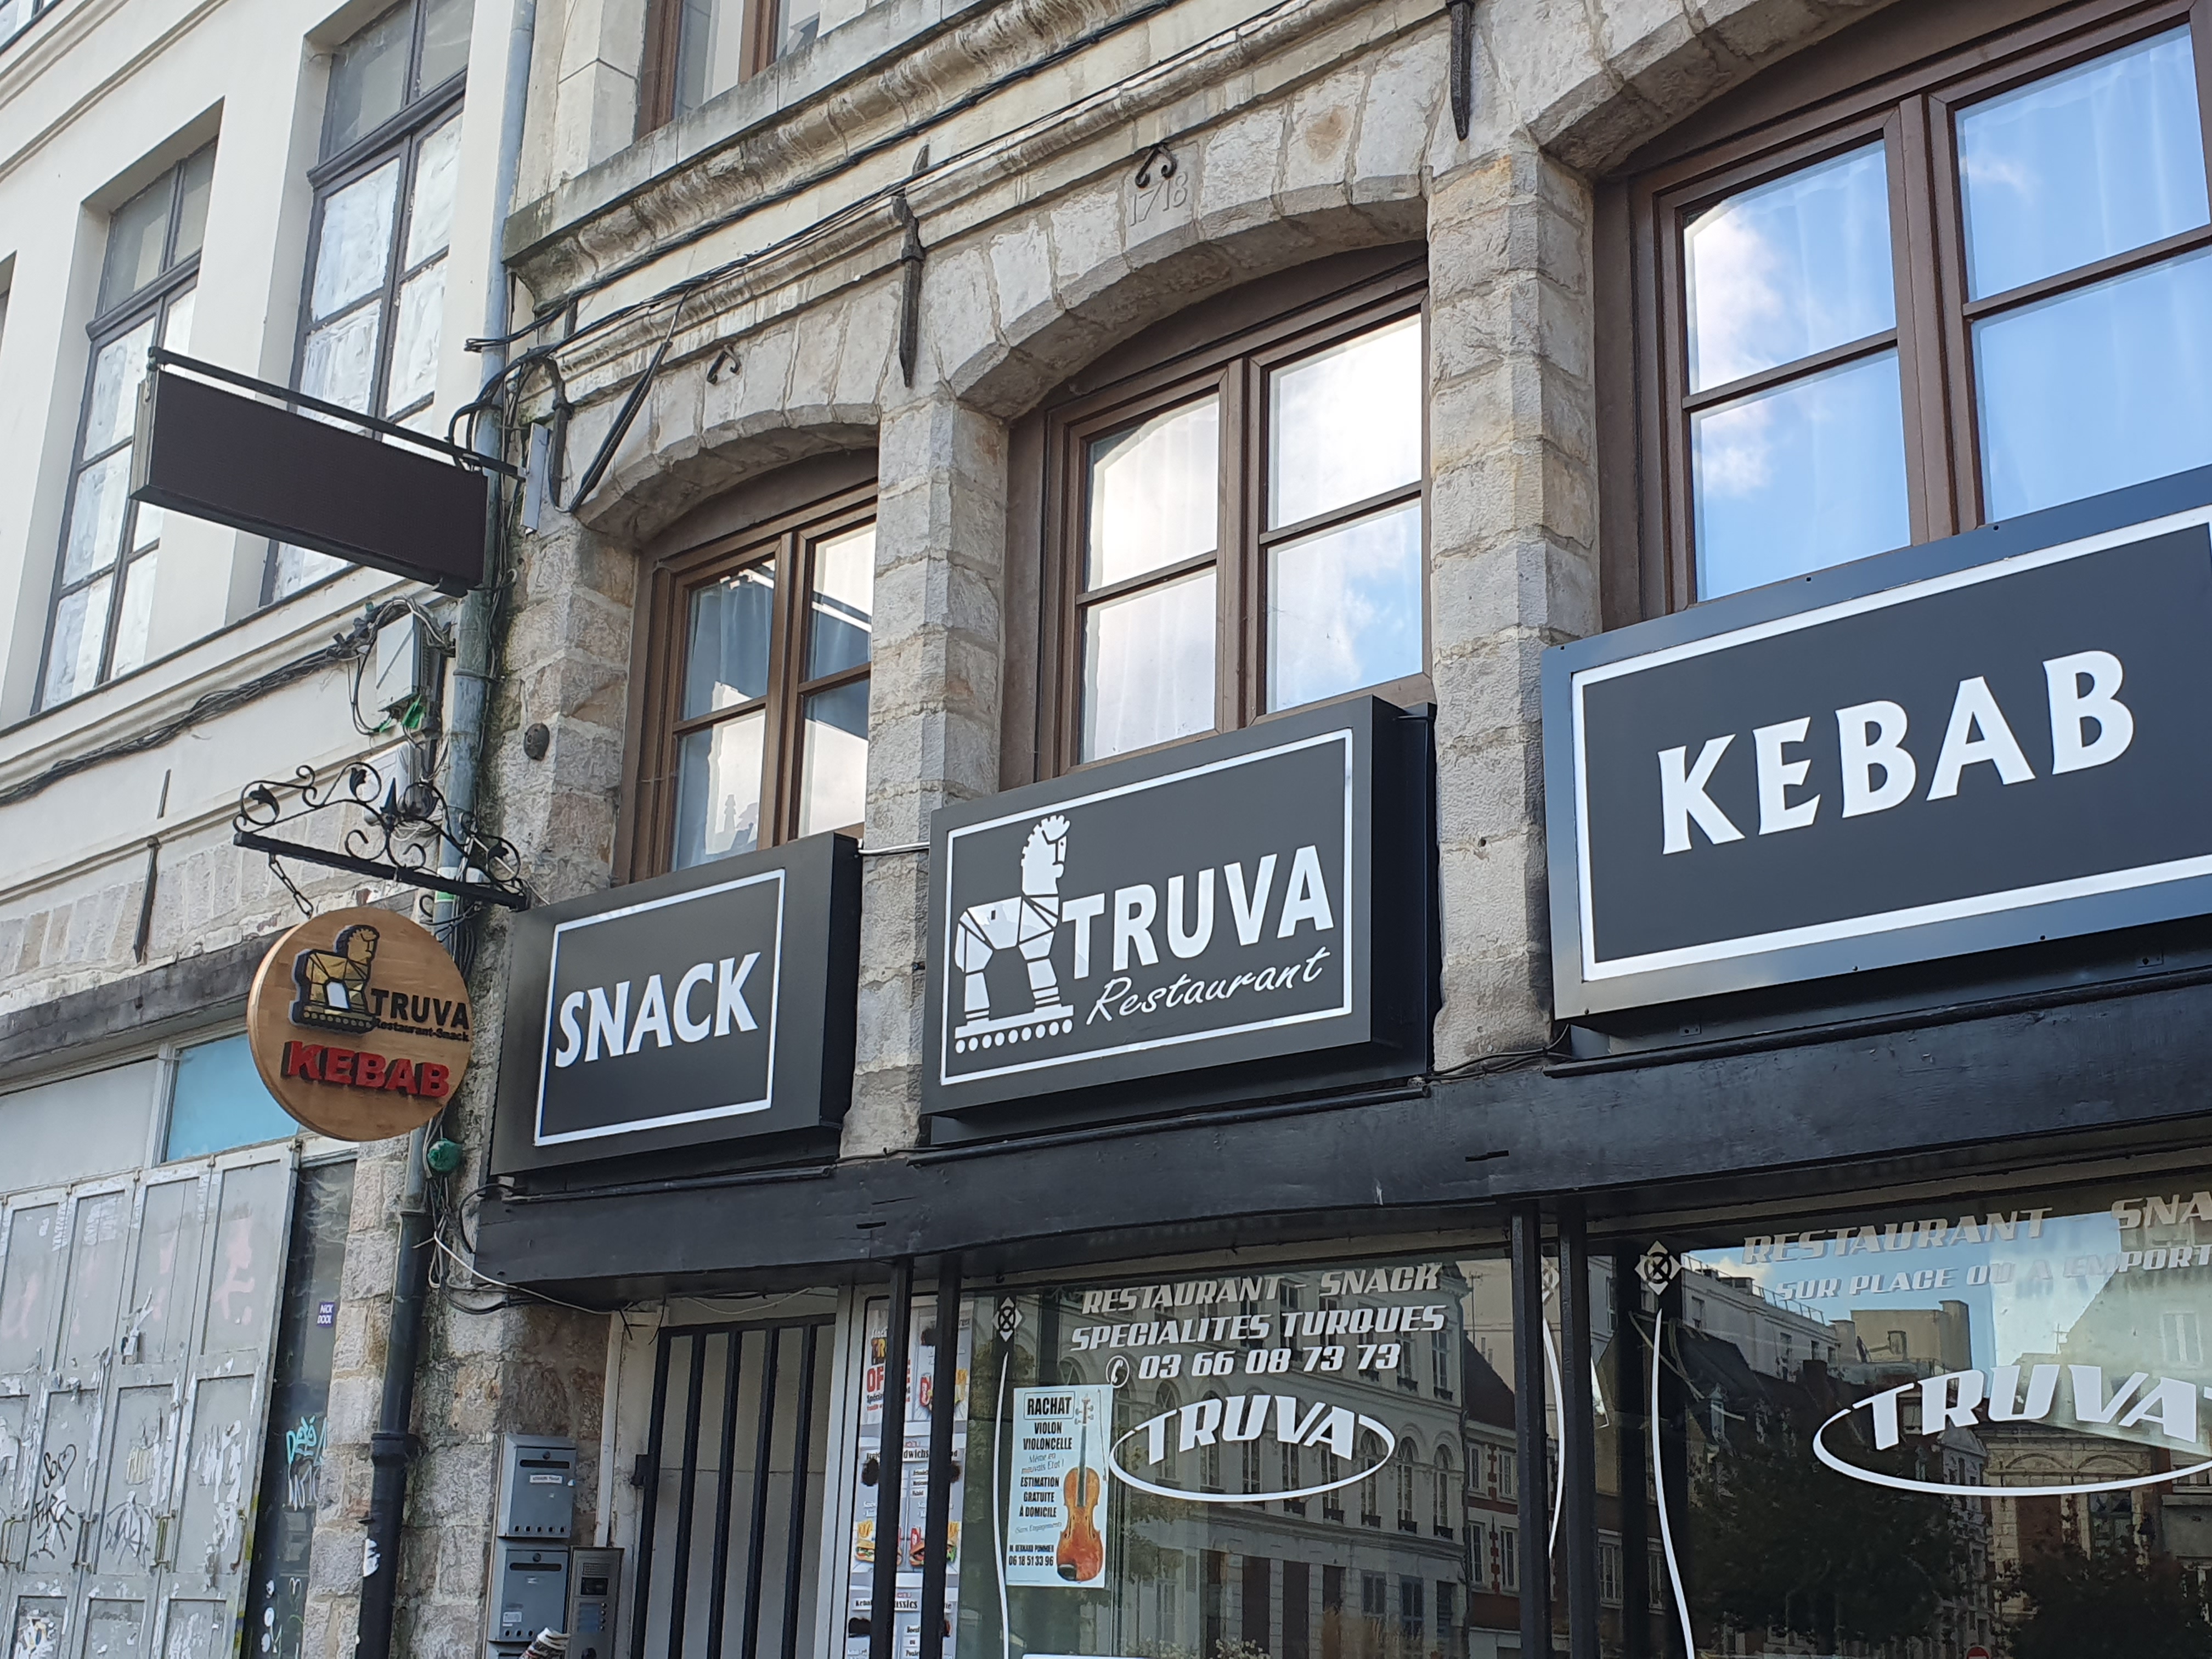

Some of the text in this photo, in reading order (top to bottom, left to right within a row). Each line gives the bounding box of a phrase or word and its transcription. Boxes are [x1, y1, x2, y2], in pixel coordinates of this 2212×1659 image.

[1657, 650, 2134, 855] KEBAB
[1062, 844, 1334, 979] TRUVA
[1086, 946, 1331, 1025] Restaurant
[370, 988, 470, 1030] TRUVA
[555, 951, 761, 1068] SNACK
[281, 1040, 450, 1097] KEBAB
[1741, 1207, 2053, 1264] RESTAURANT
[1081, 1275, 1285, 1314] RESTAURANT
[1319, 1262, 1443, 1297] SNACK
[1775, 1277, 1840, 1301] SUR
[1849, 1268, 1958, 1295] PLACE
[1966, 1262, 2014, 1286] OU
[1070, 1305, 1447, 1351] SPECIALITES TURQUES
[1138, 1343, 1401, 1379] 03 66 08 73 73
[1027, 1397, 1072, 1415] RACHAT
[1852, 1364, 2197, 1451] TRUVA
[1023, 1437, 1073, 1451] VIOLONCELLE
[1035, 1421, 1062, 1435] VIOLON
[1134, 1395, 1355, 1465] TRUVA
[904, 1448, 929, 1459] dwichs
[1020, 1477, 1059, 1487] ESTIMATION
[1023, 1492, 1055, 1503] GRATUITE
[1025, 1506, 1057, 1517] DOMICILE
[1008, 1555, 1054, 1566] 06 18 51 33 96
